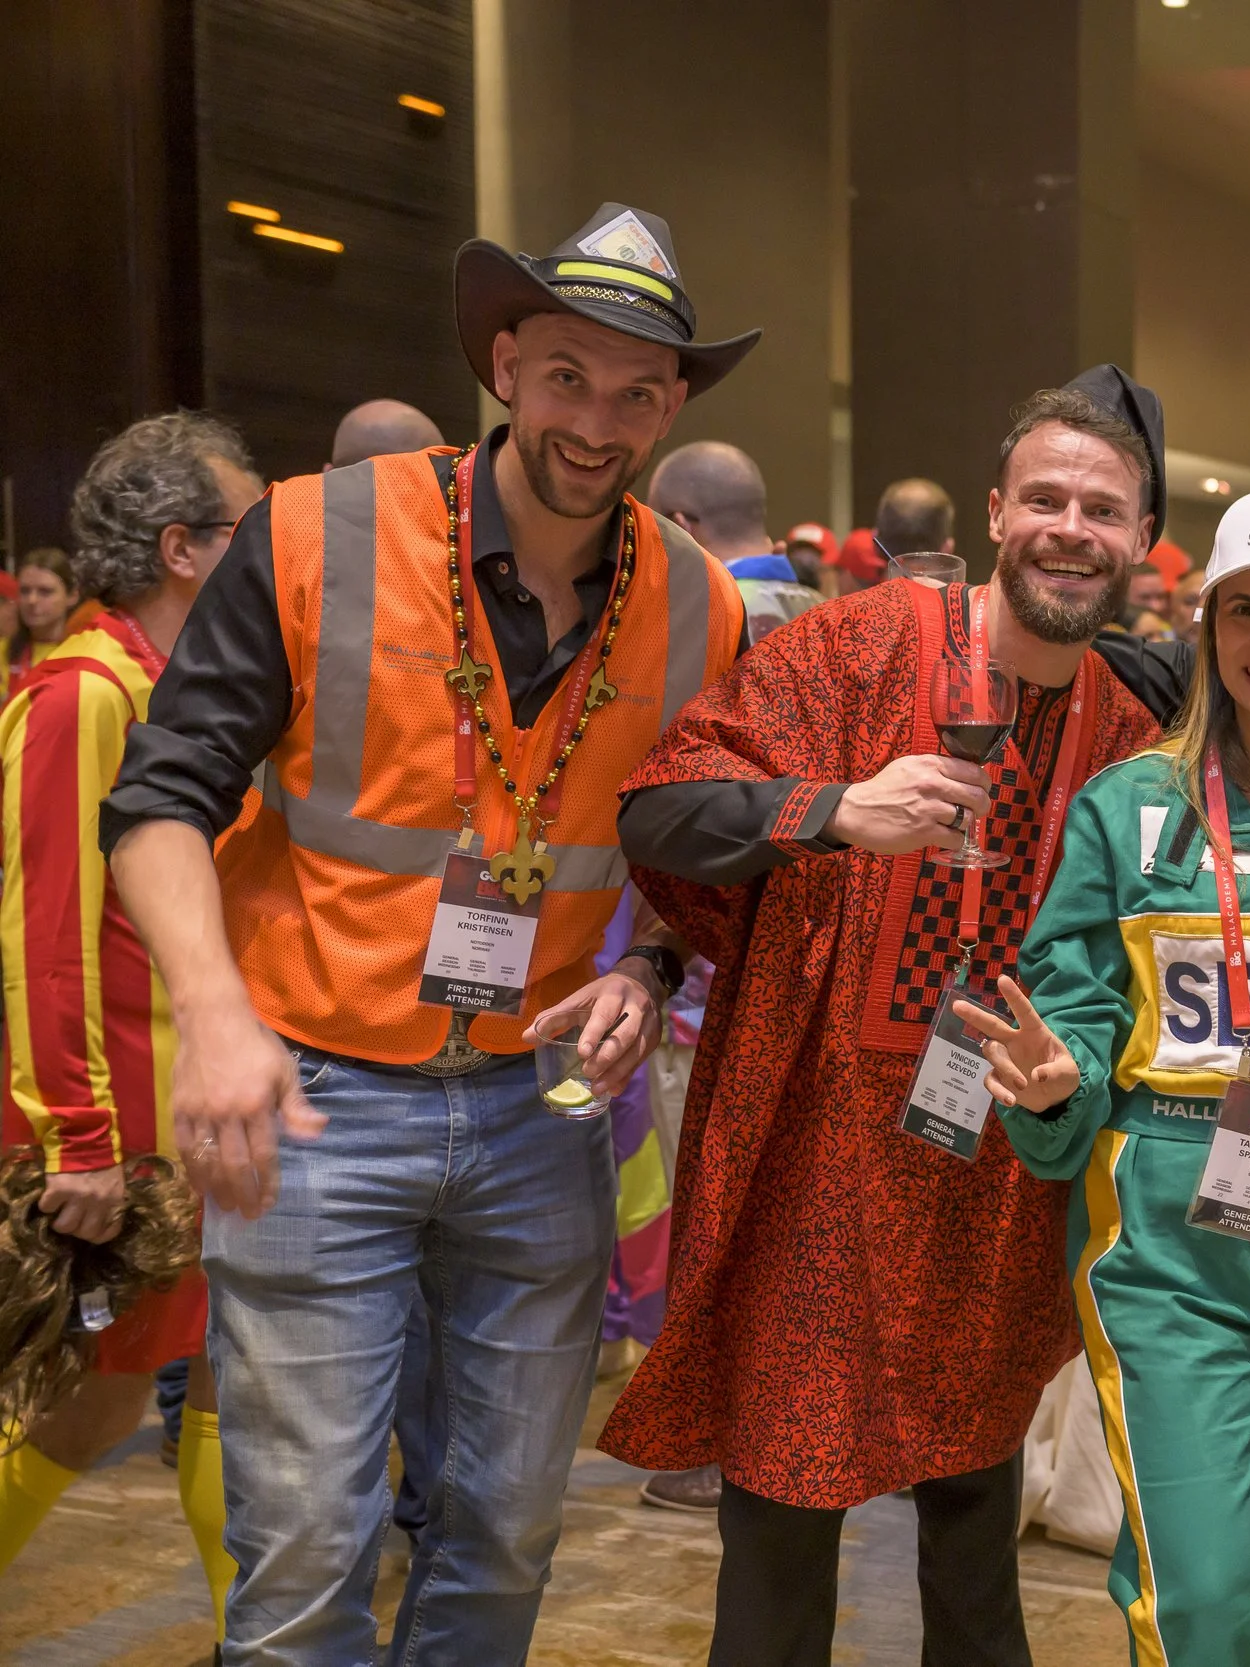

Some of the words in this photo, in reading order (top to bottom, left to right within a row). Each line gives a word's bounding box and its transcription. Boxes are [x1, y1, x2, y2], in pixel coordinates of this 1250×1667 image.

[566, 648, 592, 719] HALACADEMY
[1036, 816, 1057, 885] HALACADEMY
[1052, 786, 1064, 811] 2025
[466, 911, 509, 926] TORFINN
[1222, 877, 1238, 946] HALACADEMY
[457, 921, 514, 938] KRISTENSEN
[447, 983, 473, 995] FIRST
[474, 987, 496, 999] TIME
[445, 994, 492, 1009] ATTENDEE
[946, 1060, 977, 1080] AZEVEDO
[950, 1050, 981, 1070] VINICIOS
[926, 1117, 956, 1137] GENERAL
[921, 1127, 955, 1148] ATTENDEE
